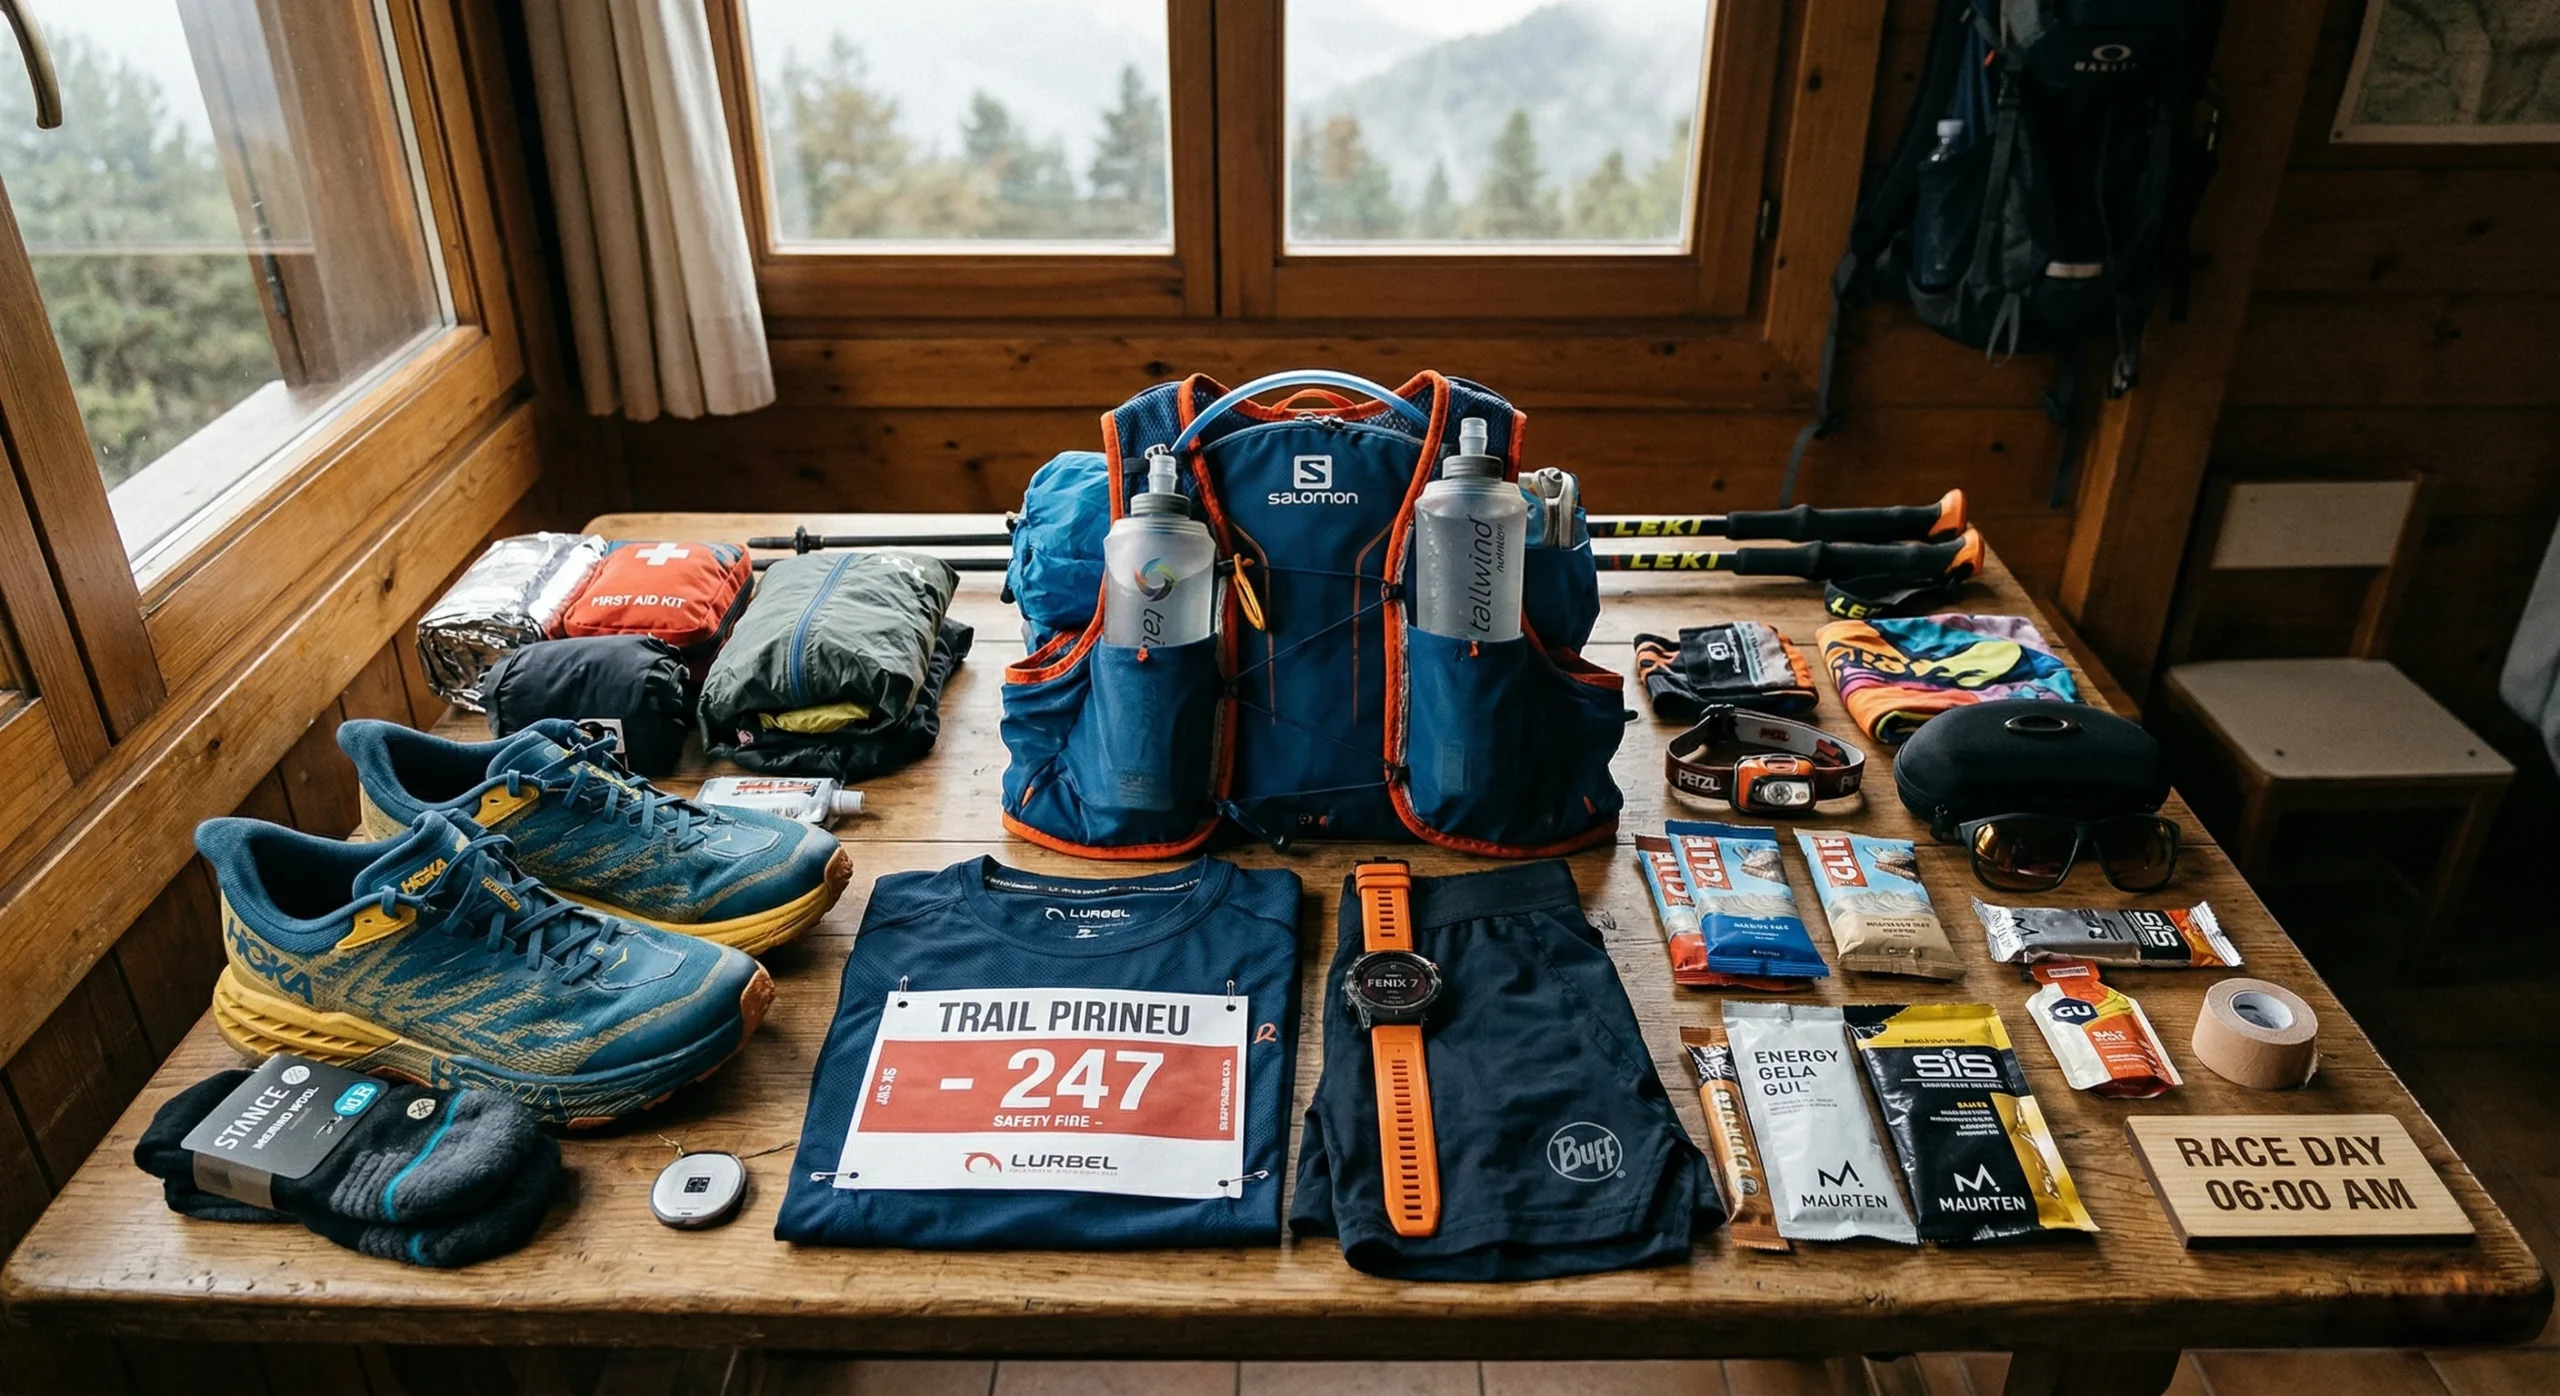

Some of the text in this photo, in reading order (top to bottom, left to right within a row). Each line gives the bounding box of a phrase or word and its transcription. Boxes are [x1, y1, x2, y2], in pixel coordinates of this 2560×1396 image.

[1613, 518, 1702, 537] LEKI
[1630, 552, 1720, 570] LEKI
[633, 594, 659, 606] AID
[660, 596, 687, 608] KIT
[1678, 768, 1722, 793] PETZL
[1687, 837, 1723, 884] CLIF
[1819, 838, 1858, 881] CLIF
[401, 857, 449, 895] HOKA
[226, 915, 316, 1006] HOKA
[1367, 978, 1419, 988] FENIX 7
[938, 1001, 1191, 1036] TRAIL PIRINEU
[2054, 1005, 2092, 1017] GU
[1754, 1049, 1838, 1064] ENERGY
[1000, 1048, 1165, 1111] 247
[1758, 1065, 1818, 1081] GELA
[1763, 1080, 1810, 1096] GUL
[213, 1085, 292, 1151] STANCE
[993, 1115, 1051, 1128] SAFETY
[1011, 1153, 1119, 1170] LURBEL
[1553, 1134, 1616, 1173] Buff
[2174, 1136, 2387, 1168] RACE DAY
[1801, 1194, 1888, 1208] MAURTEN
[1939, 1195, 2027, 1212] MAURTEN
[2204, 1178, 2418, 1211] 06:00 AM
